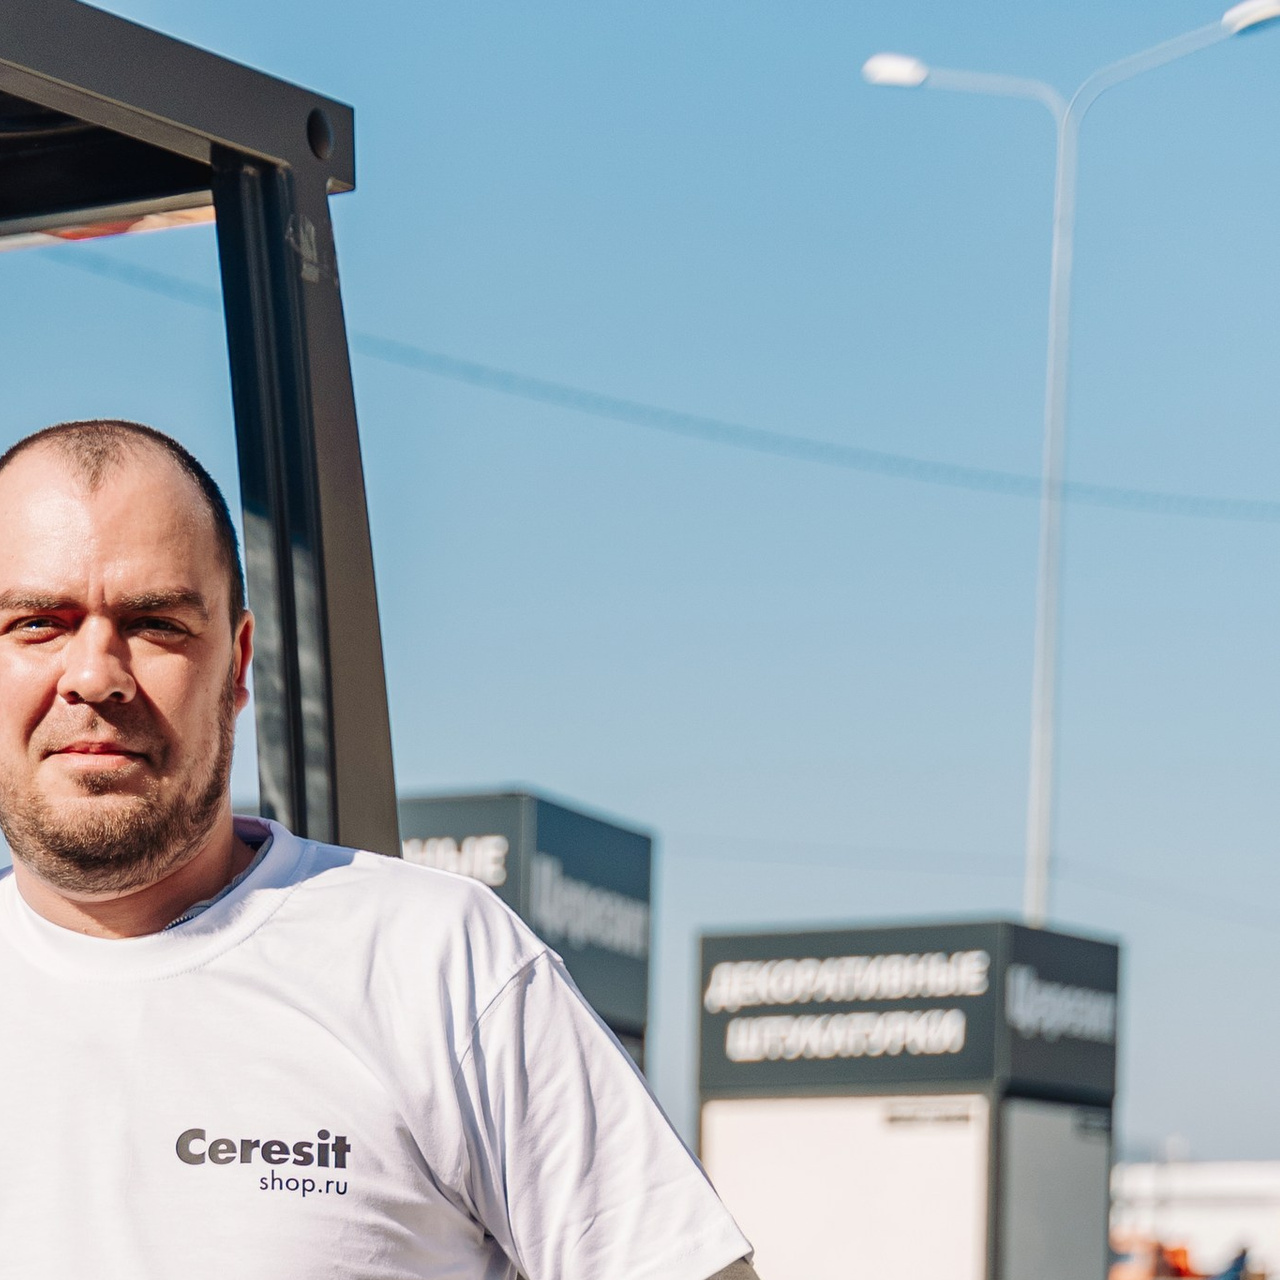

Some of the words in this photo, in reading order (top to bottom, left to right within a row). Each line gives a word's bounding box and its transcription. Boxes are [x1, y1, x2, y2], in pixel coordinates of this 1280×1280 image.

[704, 950, 990, 1013] ДЕКОРАТИВНЫЕ
[725, 1008, 967, 1062] ШТУКАТУРКИ
[175, 1128, 352, 1169] Ceresit
[259, 1169, 348, 1197] shop.ru
